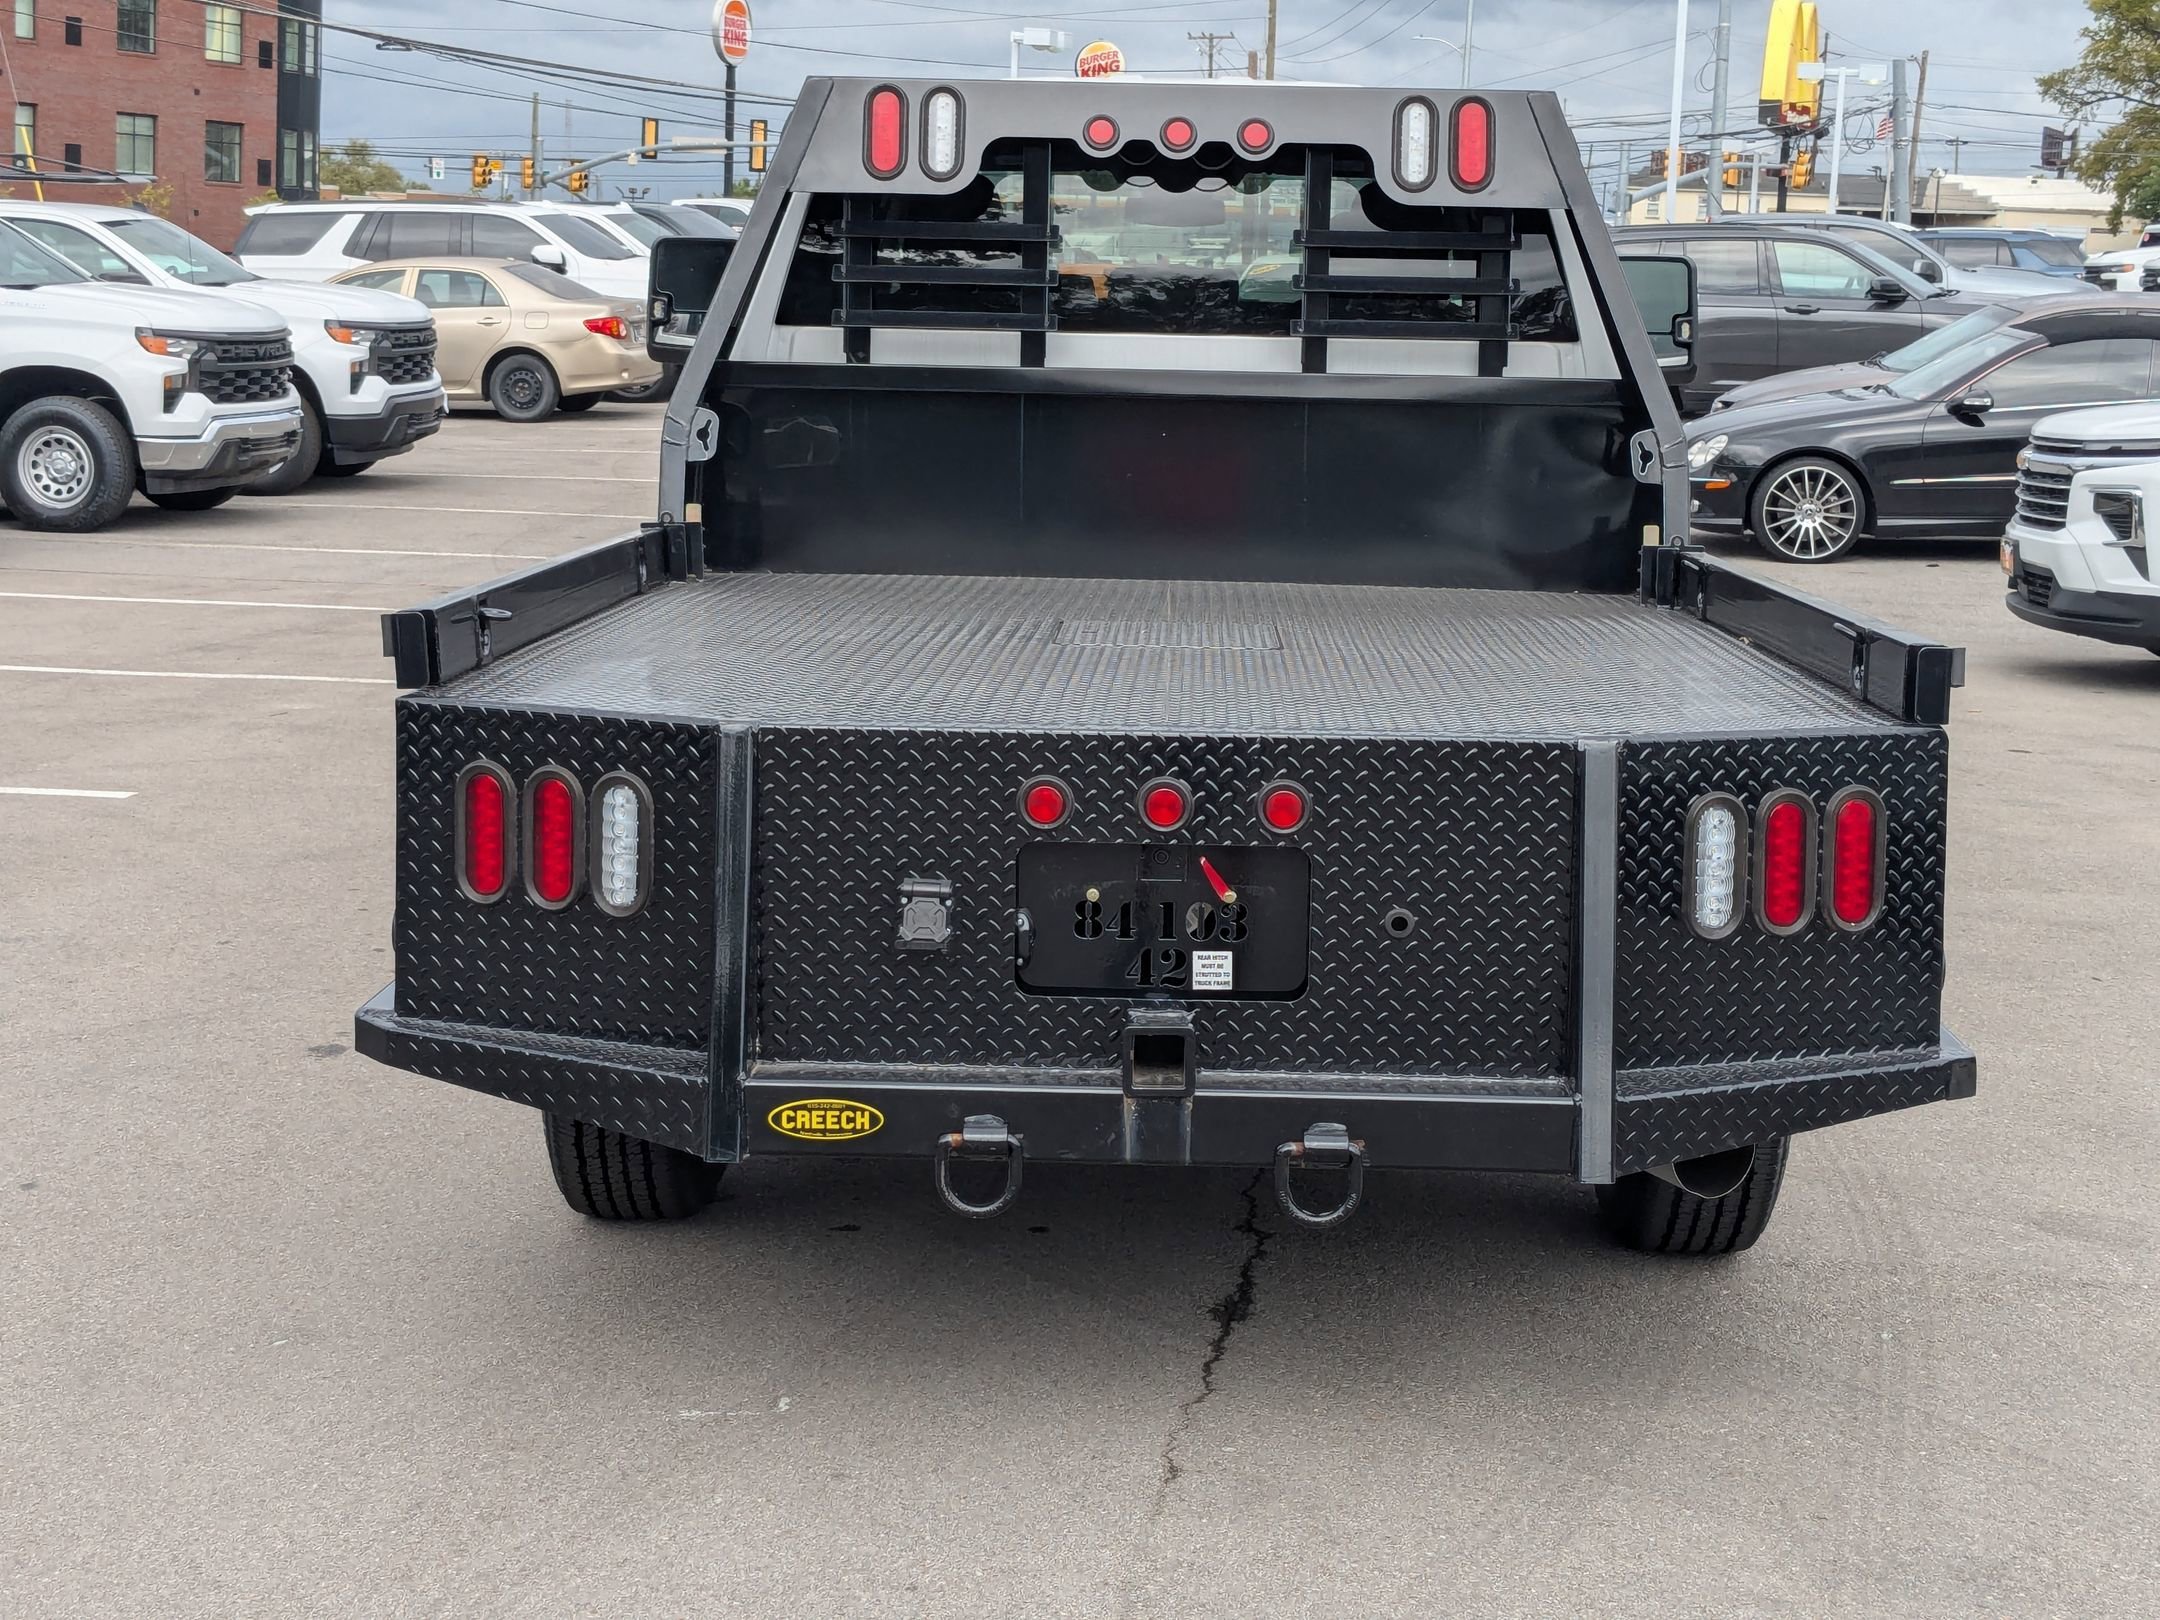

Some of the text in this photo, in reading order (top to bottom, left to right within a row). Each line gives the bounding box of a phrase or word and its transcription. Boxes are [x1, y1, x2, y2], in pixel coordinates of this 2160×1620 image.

[724, 29, 747, 47] KING
[1079, 50, 1119, 68] BURGER
[1081, 60, 1120, 77] KING
[1073, 900, 1249, 943] 84 103
[1125, 947, 1188, 988] 42
[781, 1110, 869, 1130] CREECH
